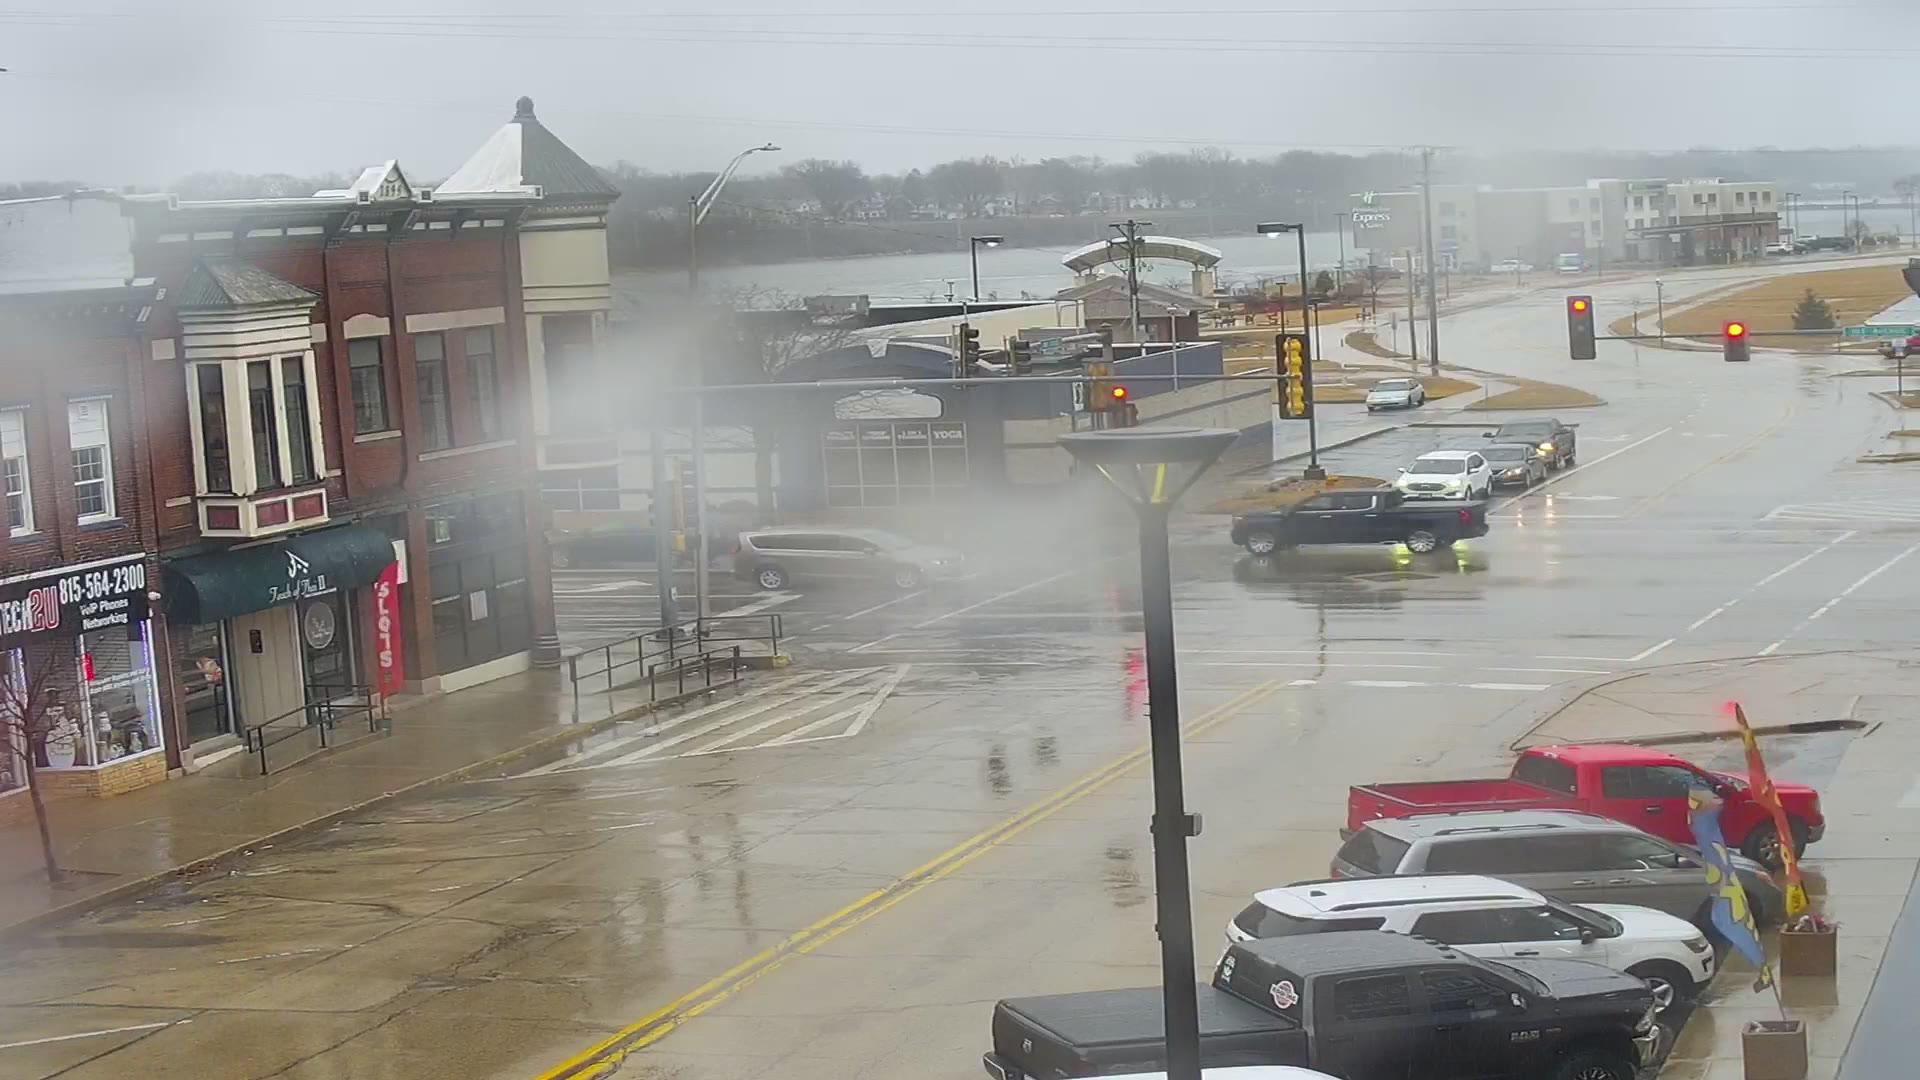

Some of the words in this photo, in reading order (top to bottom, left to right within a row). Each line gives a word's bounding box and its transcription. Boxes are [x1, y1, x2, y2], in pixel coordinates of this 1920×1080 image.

[1353, 212, 1391, 223] Express
[59, 564, 145, 605] 815-564-2300
[99, 598, 128, 612] Phones
[83, 612, 128, 630] Networking
[378, 581, 393, 668] SLOTS
